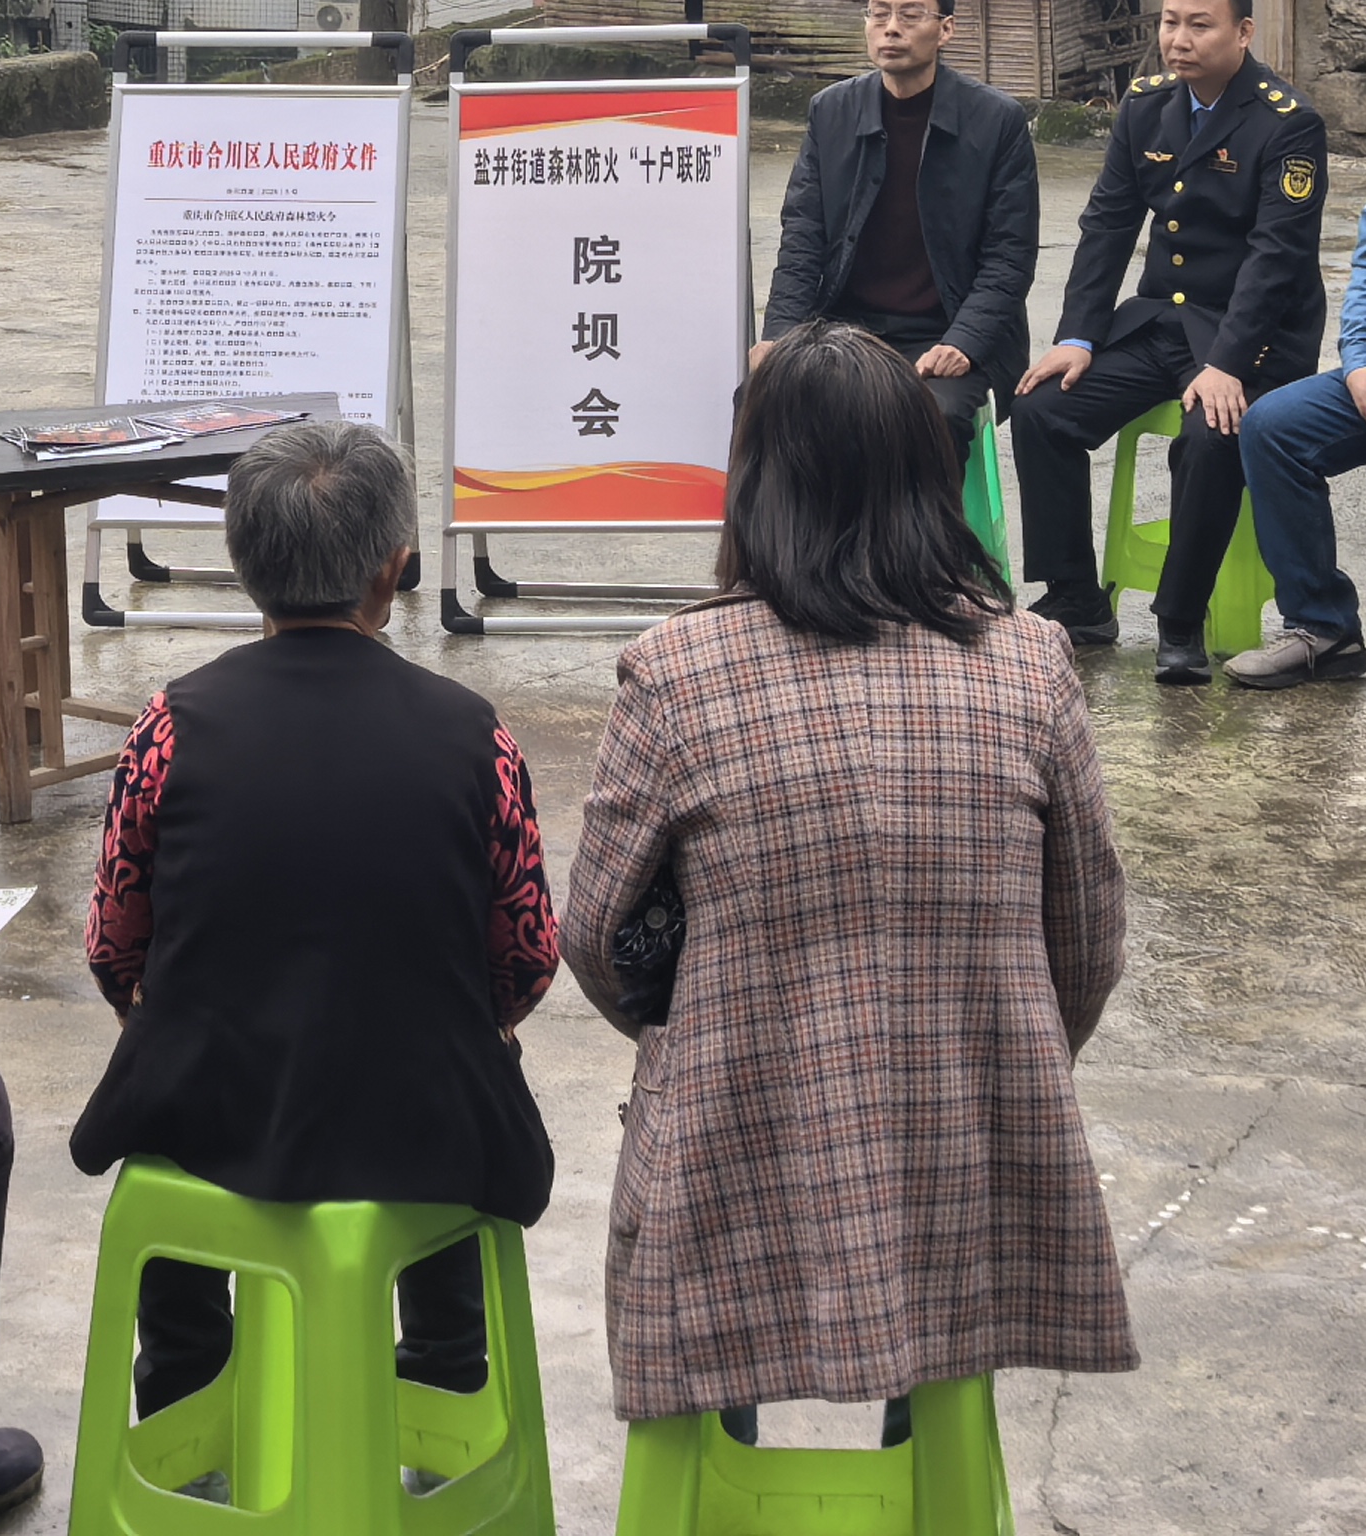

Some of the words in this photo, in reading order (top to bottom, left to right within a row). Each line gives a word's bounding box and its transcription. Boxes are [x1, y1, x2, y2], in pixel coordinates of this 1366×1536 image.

[147, 140, 378, 171] 重庆市合川区人民政府文件
[473, 143, 723, 186] 盐井街道森林防火“十户联防”
[571, 235, 622, 437] 院坝会
